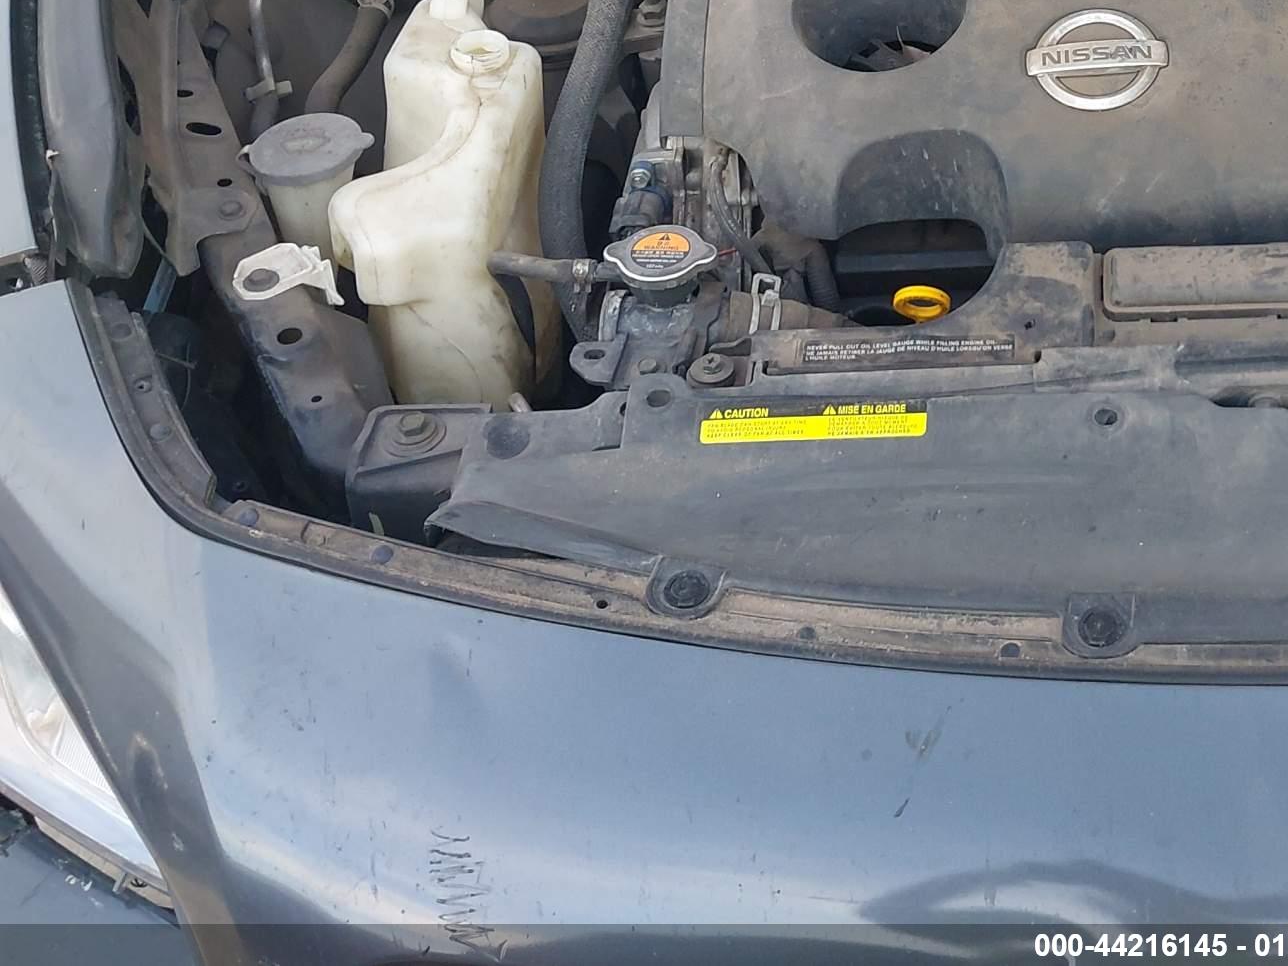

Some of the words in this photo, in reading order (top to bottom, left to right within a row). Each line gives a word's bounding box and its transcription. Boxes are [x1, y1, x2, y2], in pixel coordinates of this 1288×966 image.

[1041, 44, 1153, 66] NISSAN
[724, 408, 769, 418] CAUTION
[837, 405, 860, 415] MISE
[861, 404, 874, 414] EN
[875, 404, 907, 414] GARDE
